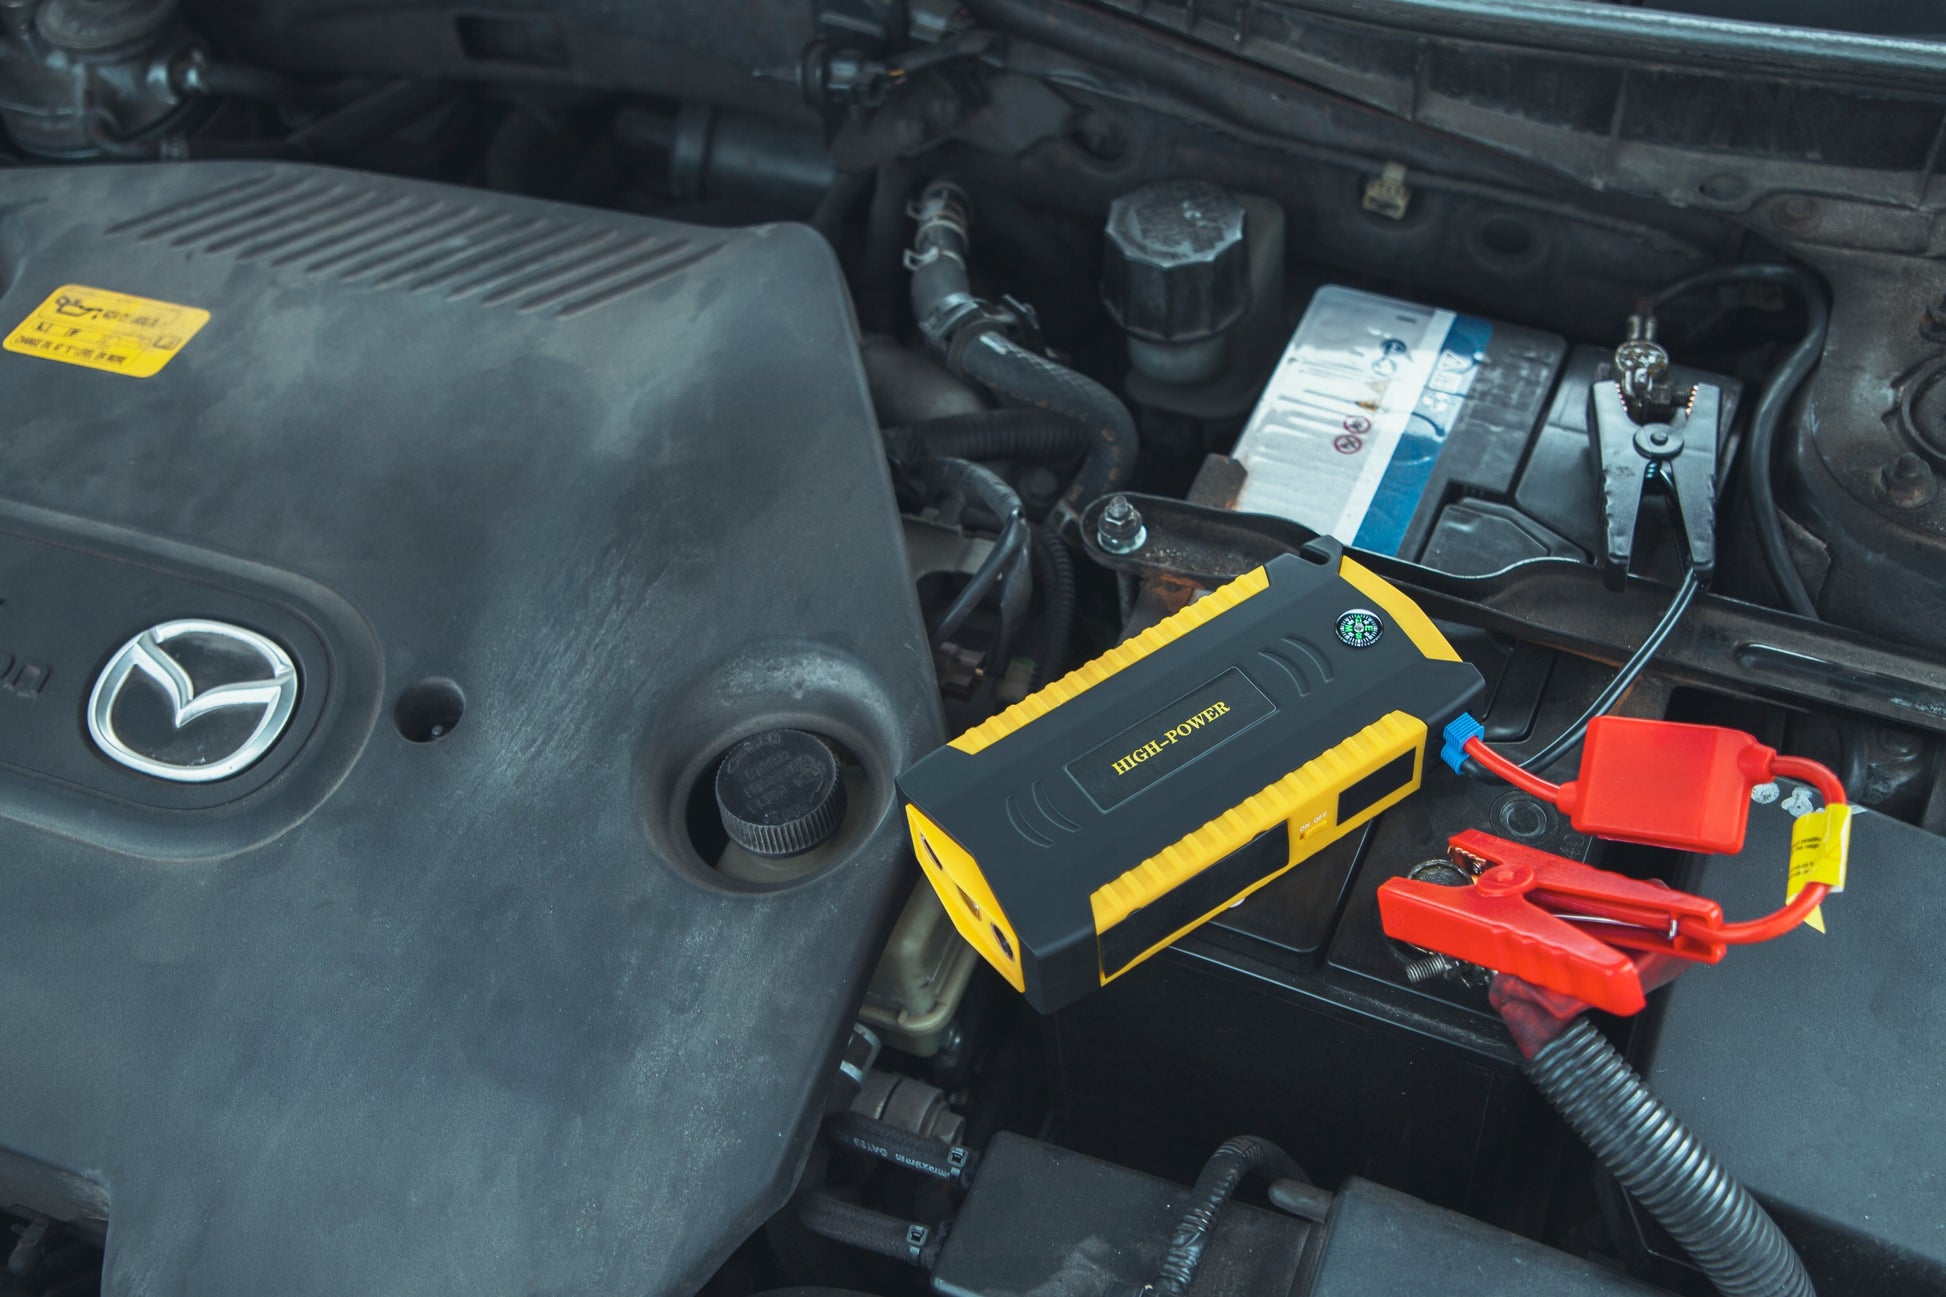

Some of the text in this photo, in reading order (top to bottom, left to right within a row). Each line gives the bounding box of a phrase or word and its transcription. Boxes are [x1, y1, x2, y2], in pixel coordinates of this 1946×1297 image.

[1111, 701, 1231, 776] HIGH-POWER
[1299, 811, 1327, 832] ON OFF
